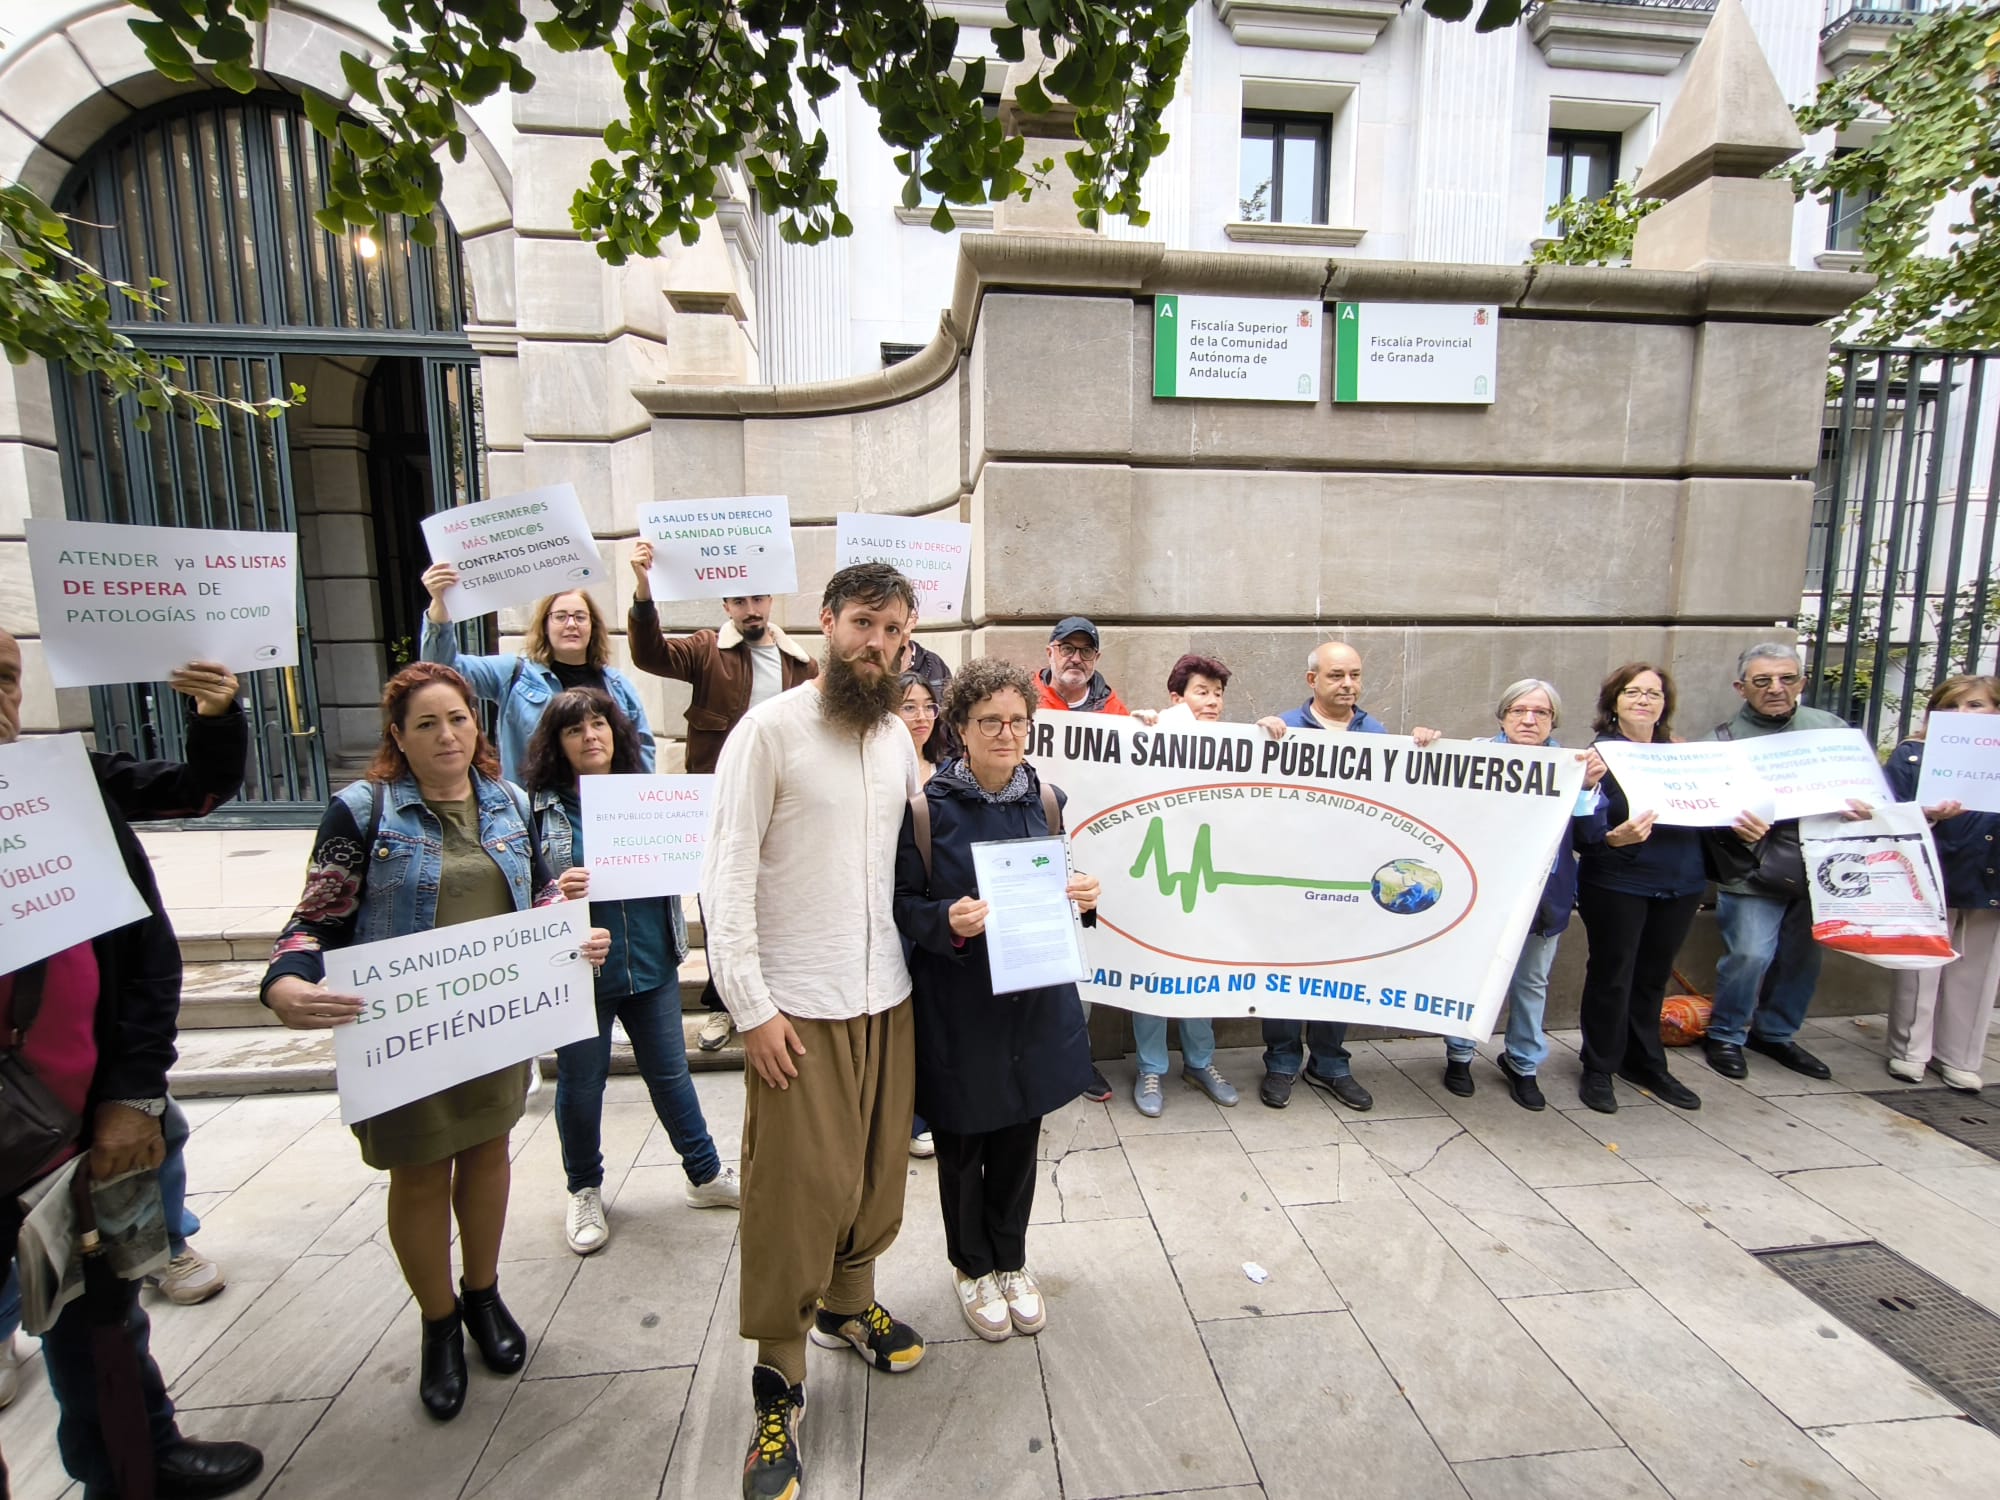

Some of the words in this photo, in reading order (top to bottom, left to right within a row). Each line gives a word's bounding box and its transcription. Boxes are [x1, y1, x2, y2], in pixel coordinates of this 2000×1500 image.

[1190, 319, 1234, 332] Fiscalía
[1237, 321, 1288, 335] Superior
[1190, 336, 1204, 346] de
[1207, 336, 1218, 347] la
[1221, 337, 1288, 349] Comunidad
[1371, 336, 1413, 347] Fiscalía
[1416, 337, 1472, 348] Provincial
[1190, 351, 1250, 363] Autónoma
[1253, 354, 1267, 364] de
[1370, 352, 1384, 362] de
[1387, 352, 1434, 362] Granada
[1189, 367, 1247, 379] Andalucía
[443, 520, 469, 534] MÁS
[470, 501, 548, 527] ENFERMER@S
[649, 514, 661, 524] LA
[663, 513, 695, 523] SALUD
[698, 513, 709, 521] ES
[711, 512, 726, 521] UN
[728, 509, 773, 520] DERECHO
[461, 536, 488, 550] MÁS
[489, 522, 544, 543] MEDIC@S
[658, 530, 672, 540] LA
[675, 528, 725, 539] SANIDAD
[728, 525, 773, 536] PÚBLICA
[701, 546, 720, 557] NO
[723, 545, 737, 555] SE
[847, 536, 859, 546] LA
[861, 537, 893, 548] SALUD
[895, 539, 906, 549] ES
[909, 541, 922, 550] UN
[924, 542, 962, 554] DERECHO
[58, 550, 159, 568] ATENDER
[175, 557, 195, 570] ya
[205, 555, 236, 569] LAS
[242, 555, 287, 569] LISTAS
[457, 544, 526, 571] CONTRATOS
[528, 536, 570, 553] DIGNOS
[849, 556, 860, 565] LA
[462, 564, 531, 590] ESTABILIDAD
[533, 553, 580, 571] LABORAL
[695, 565, 748, 580] VENDE
[63, 580, 95, 595] DE
[103, 580, 187, 596] ESPERA
[199, 583, 222, 596] DE
[912, 579, 939, 591] ENDE
[67, 606, 196, 623] PATOLOGÍAS
[206, 611, 226, 621] no
[230, 606, 270, 619] COVID
[1940, 735, 1970, 745] CON
[1064, 725, 1121, 764] UNA
[1130, 731, 1252, 773] SANIDAD
[1261, 735, 1372, 781] PÚBLICA
[1383, 749, 1399, 782] Y
[1405, 751, 1561, 797] UNIVERSAL
[1932, 768, 1953, 778] NO
[1664, 782, 1681, 790] NO
[1774, 786, 1793, 794] NO
[638, 789, 700, 802] VACUNAS
[1665, 797, 1720, 810] VENDE
[596, 813, 616, 822] BIEN
[654, 811, 663, 820] DE
[1087, 810, 1134, 836] MESA
[1136, 802, 1161, 816] EN
[1163, 787, 1245, 809] DEFENSA
[1250, 787, 1273, 798] DE
[1278, 788, 1300, 801] LA
[1305, 791, 1378, 817] SANIDAD
[1380, 812, 1445, 854] PÚBLICA
[685, 833, 697, 843] DE
[595, 854, 650, 866] PATENTES
[662, 850, 704, 862] TRANSP
[11, 886, 76, 920] SALUD
[1304, 891, 1360, 903] Granada
[352, 966, 382, 987] LA
[389, 940, 487, 978] SANIDAD
[493, 920, 572, 952] PÚBLICA
[357, 1000, 386, 1025] ES
[396, 987, 429, 1013] DE
[436, 963, 520, 1001] TODOS
[1090, 967, 1122, 987] AD
[1129, 971, 1220, 995] PÚBLICA
[1228, 973, 1256, 992] NO
[1265, 973, 1292, 993] SE
[1298, 976, 1372, 1006] VENDE,
[1379, 987, 1407, 1008] SE
